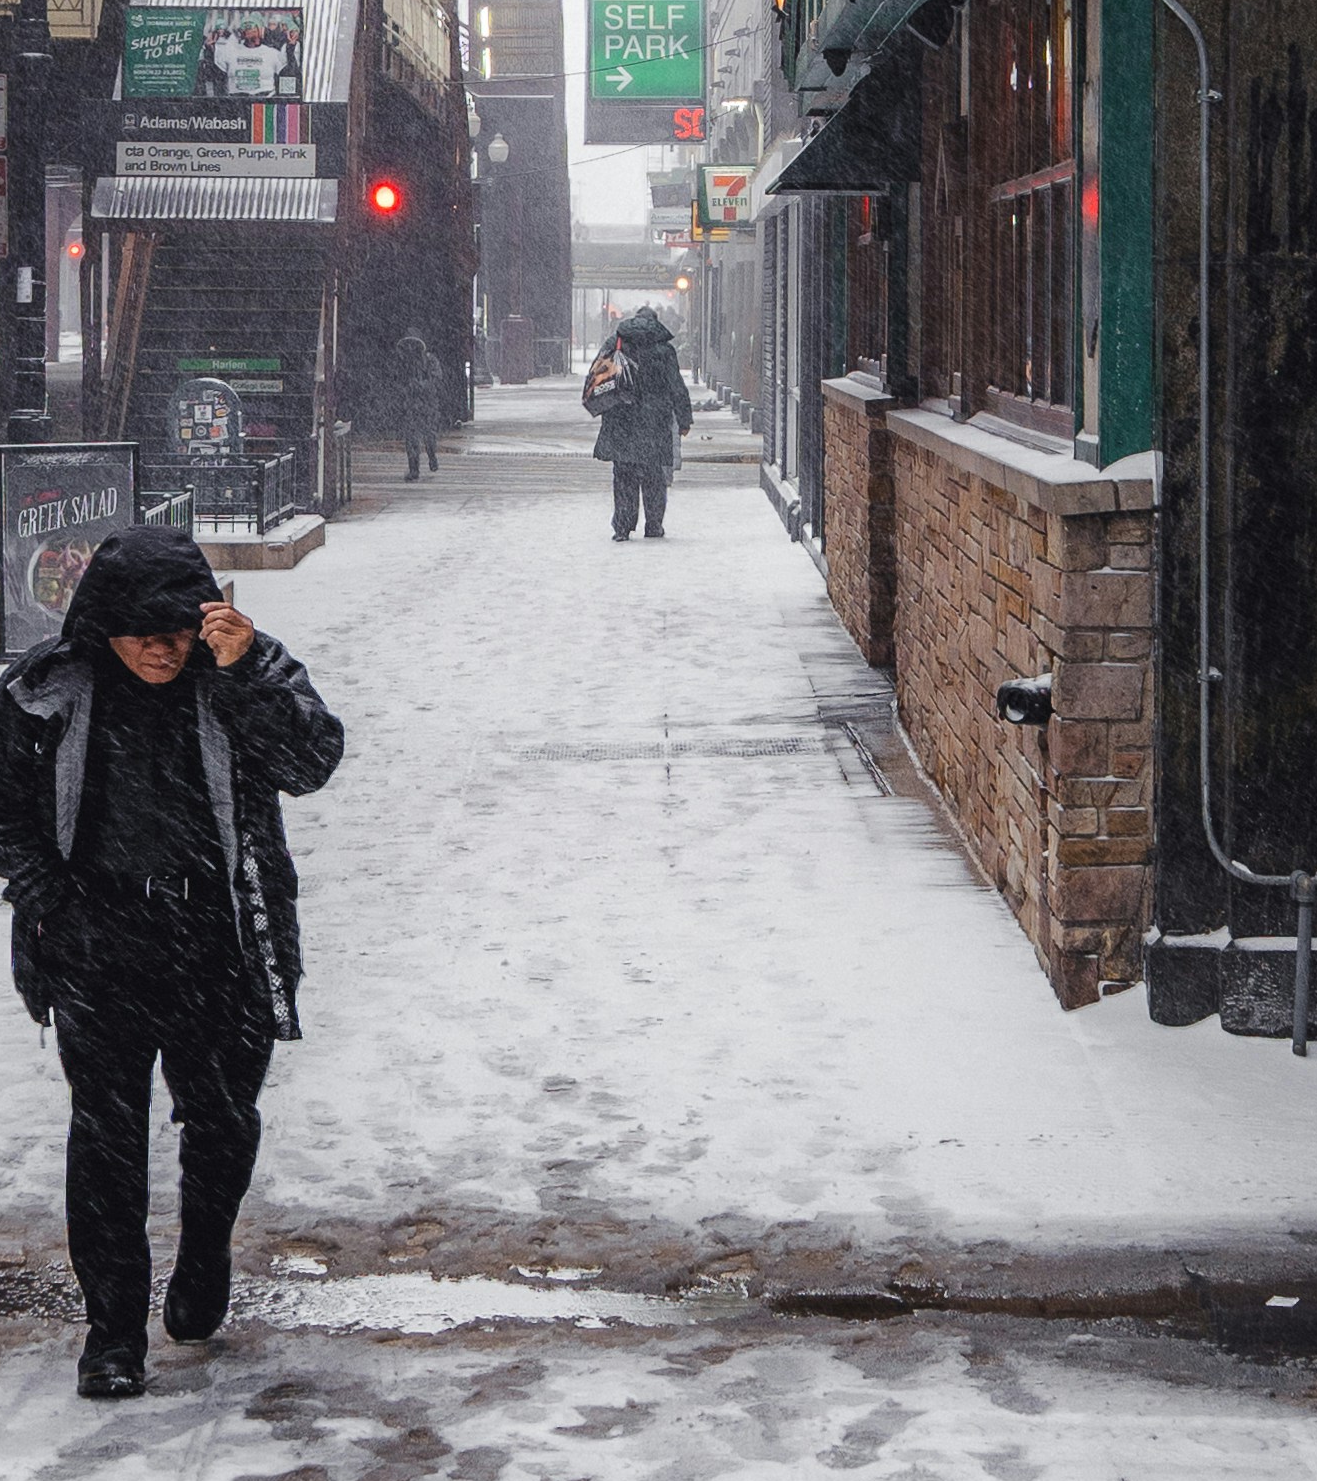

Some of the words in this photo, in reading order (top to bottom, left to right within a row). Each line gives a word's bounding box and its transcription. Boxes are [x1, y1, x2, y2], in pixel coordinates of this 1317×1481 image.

[604, 4, 686, 31] SELF
[130, 29, 193, 50] SHUFFLE
[604, 35, 689, 61] PARK
[143, 47, 163, 60] TO
[165, 43, 184, 56] 8K
[139, 114, 247, 131] Adams/Wabash
[125, 146, 144, 156] cta
[148, 146, 193, 159] Orange,
[196, 147, 234, 160] Green,
[238, 148, 278, 161] Purple,
[281, 148, 307, 159] Pink
[125, 160, 146, 171] and
[150, 161, 187, 172] Brown
[191, 161, 221, 172] Lines
[18, 498, 68, 538] GREEK
[71, 487, 118, 525] SALAD
